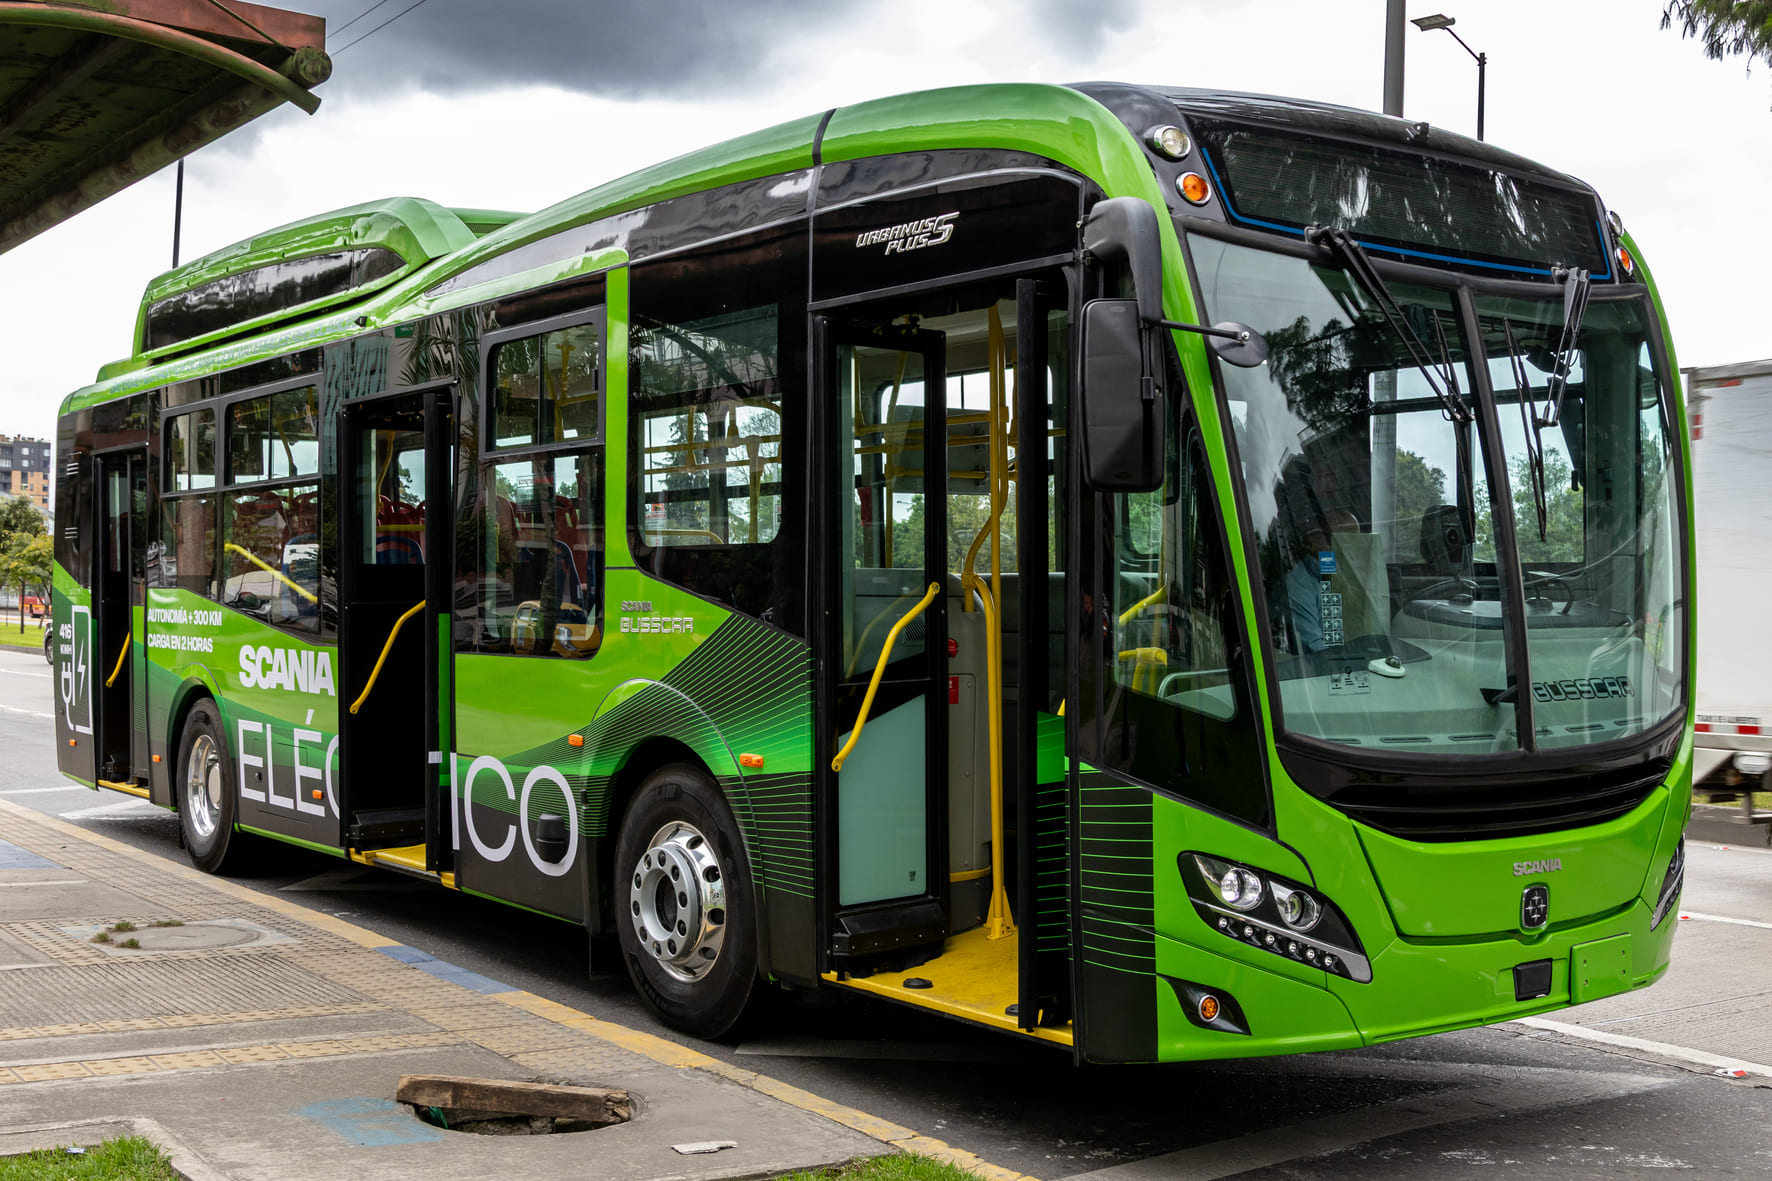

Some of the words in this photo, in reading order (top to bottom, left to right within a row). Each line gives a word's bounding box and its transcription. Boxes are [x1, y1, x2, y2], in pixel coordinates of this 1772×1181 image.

[148, 606, 187, 624] AUTONOMÍA
[193, 609, 209, 626] 300
[208, 610, 223, 627] KM
[620, 600, 653, 613] SCANIA
[59, 623, 73, 640] 416
[620, 617, 694, 634] BUSSCAR
[147, 633, 170, 648] CARGA
[170, 634, 181, 650] EN
[181, 635, 187, 651] 2
[187, 635, 214, 653] HORAS
[239, 644, 336, 697] SCANIA
[1531, 675, 1636, 703] BUSSCAR
[1512, 857, 1563, 877] SCANIA
